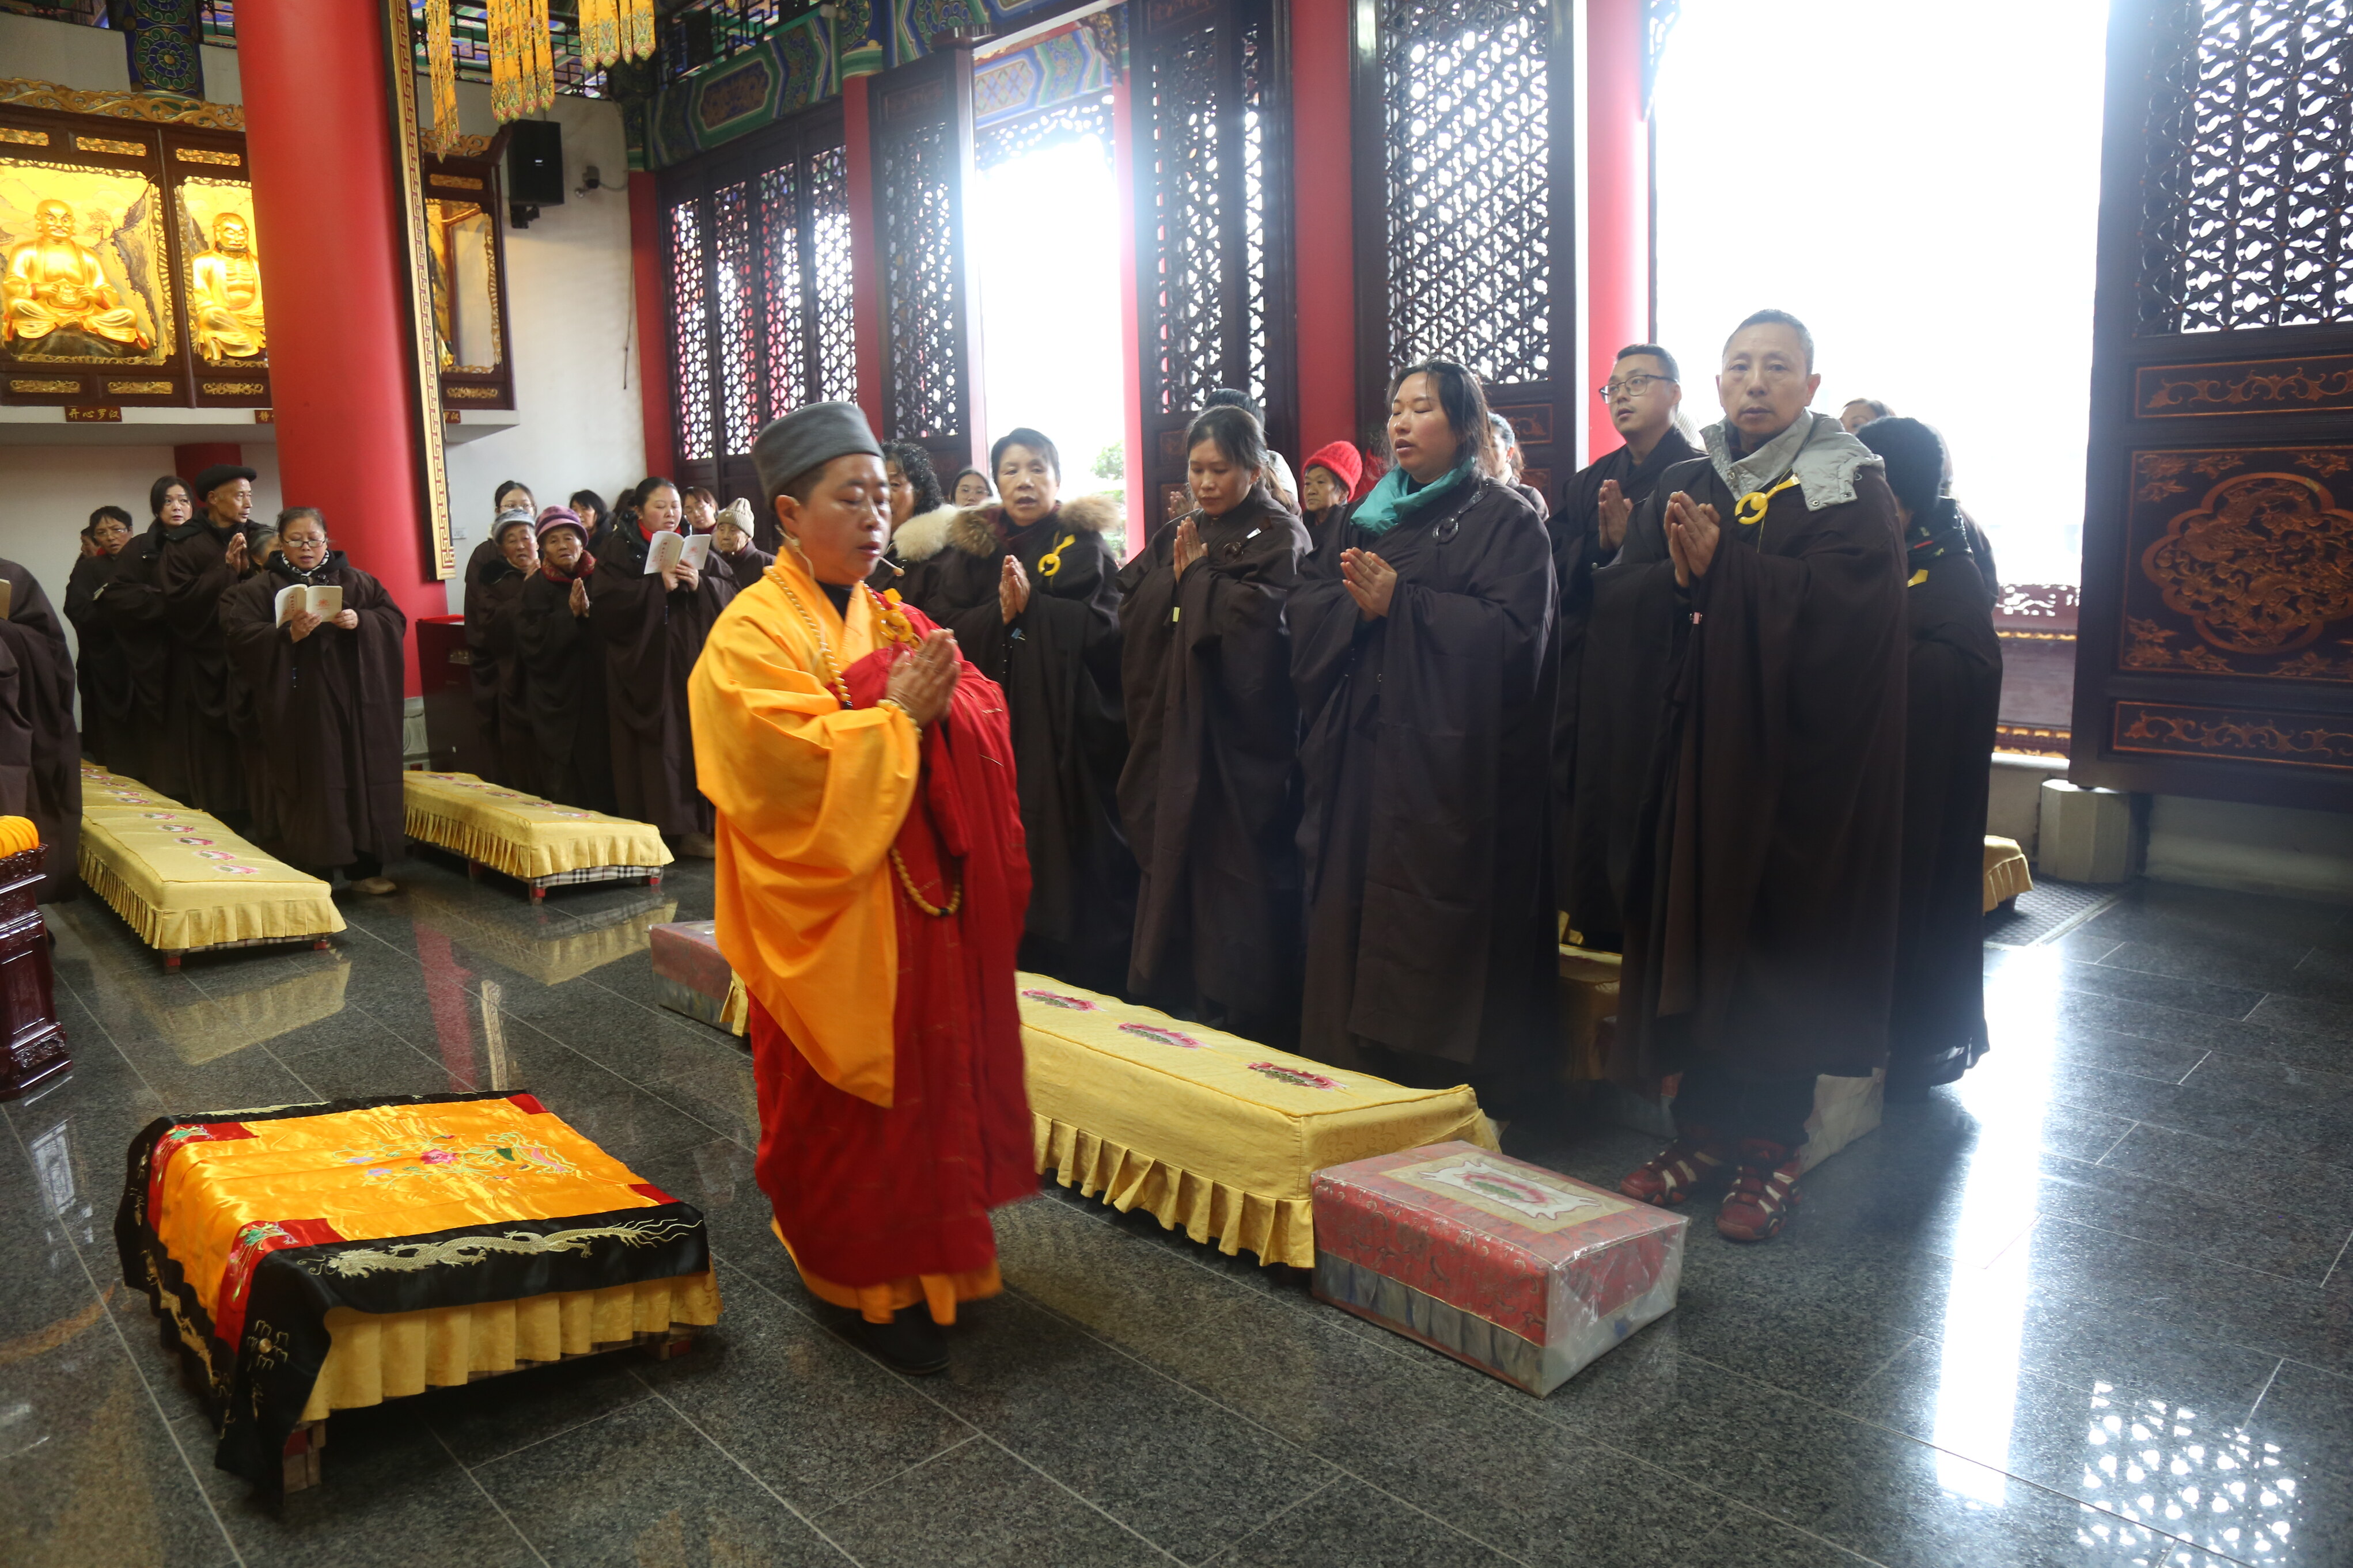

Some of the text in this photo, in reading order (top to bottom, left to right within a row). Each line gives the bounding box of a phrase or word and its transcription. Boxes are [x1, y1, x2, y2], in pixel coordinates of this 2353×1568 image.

[69, 408, 120, 420] 开心罗汉
[259, 411, 274, 422] 静
